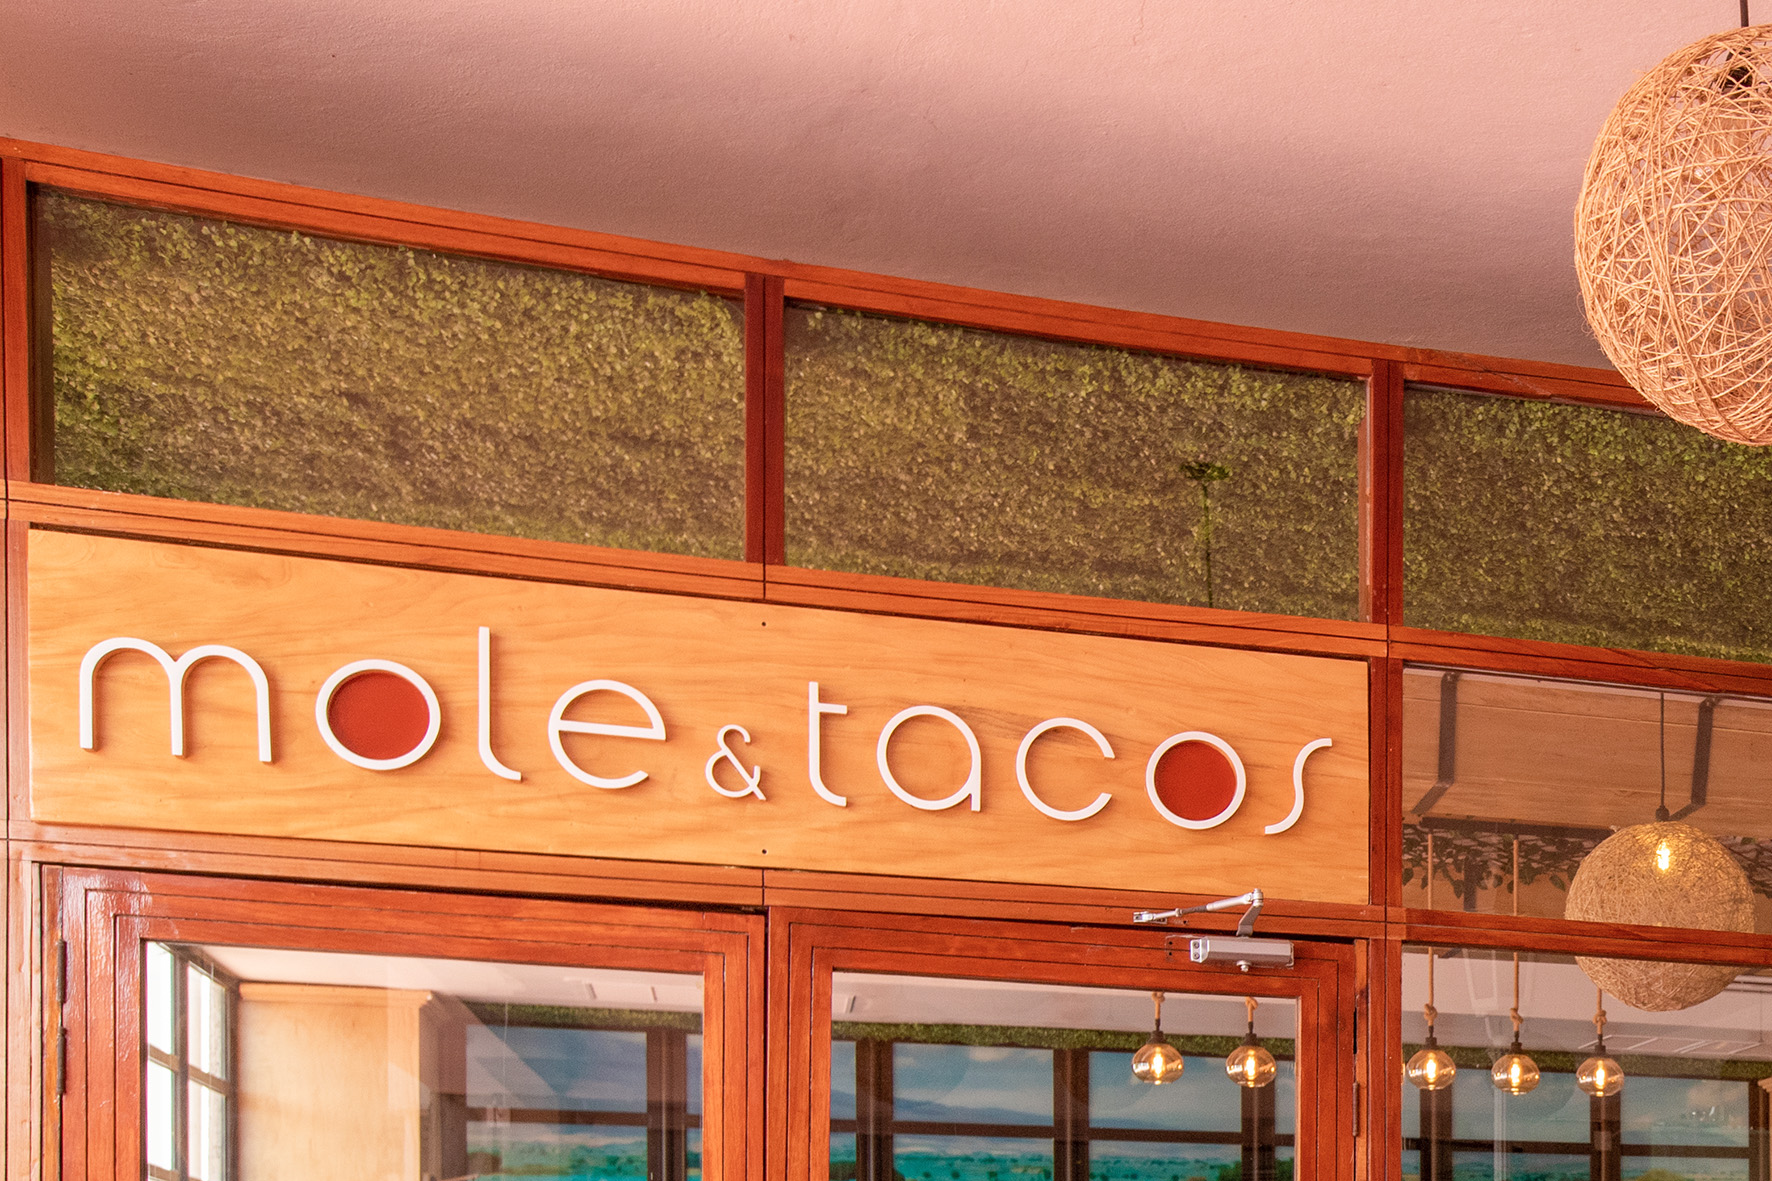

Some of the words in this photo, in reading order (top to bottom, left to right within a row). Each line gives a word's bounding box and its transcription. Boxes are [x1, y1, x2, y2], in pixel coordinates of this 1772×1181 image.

[79, 625, 667, 790] mole
[704, 723, 766, 800] &
[808, 680, 1334, 836] tacos
